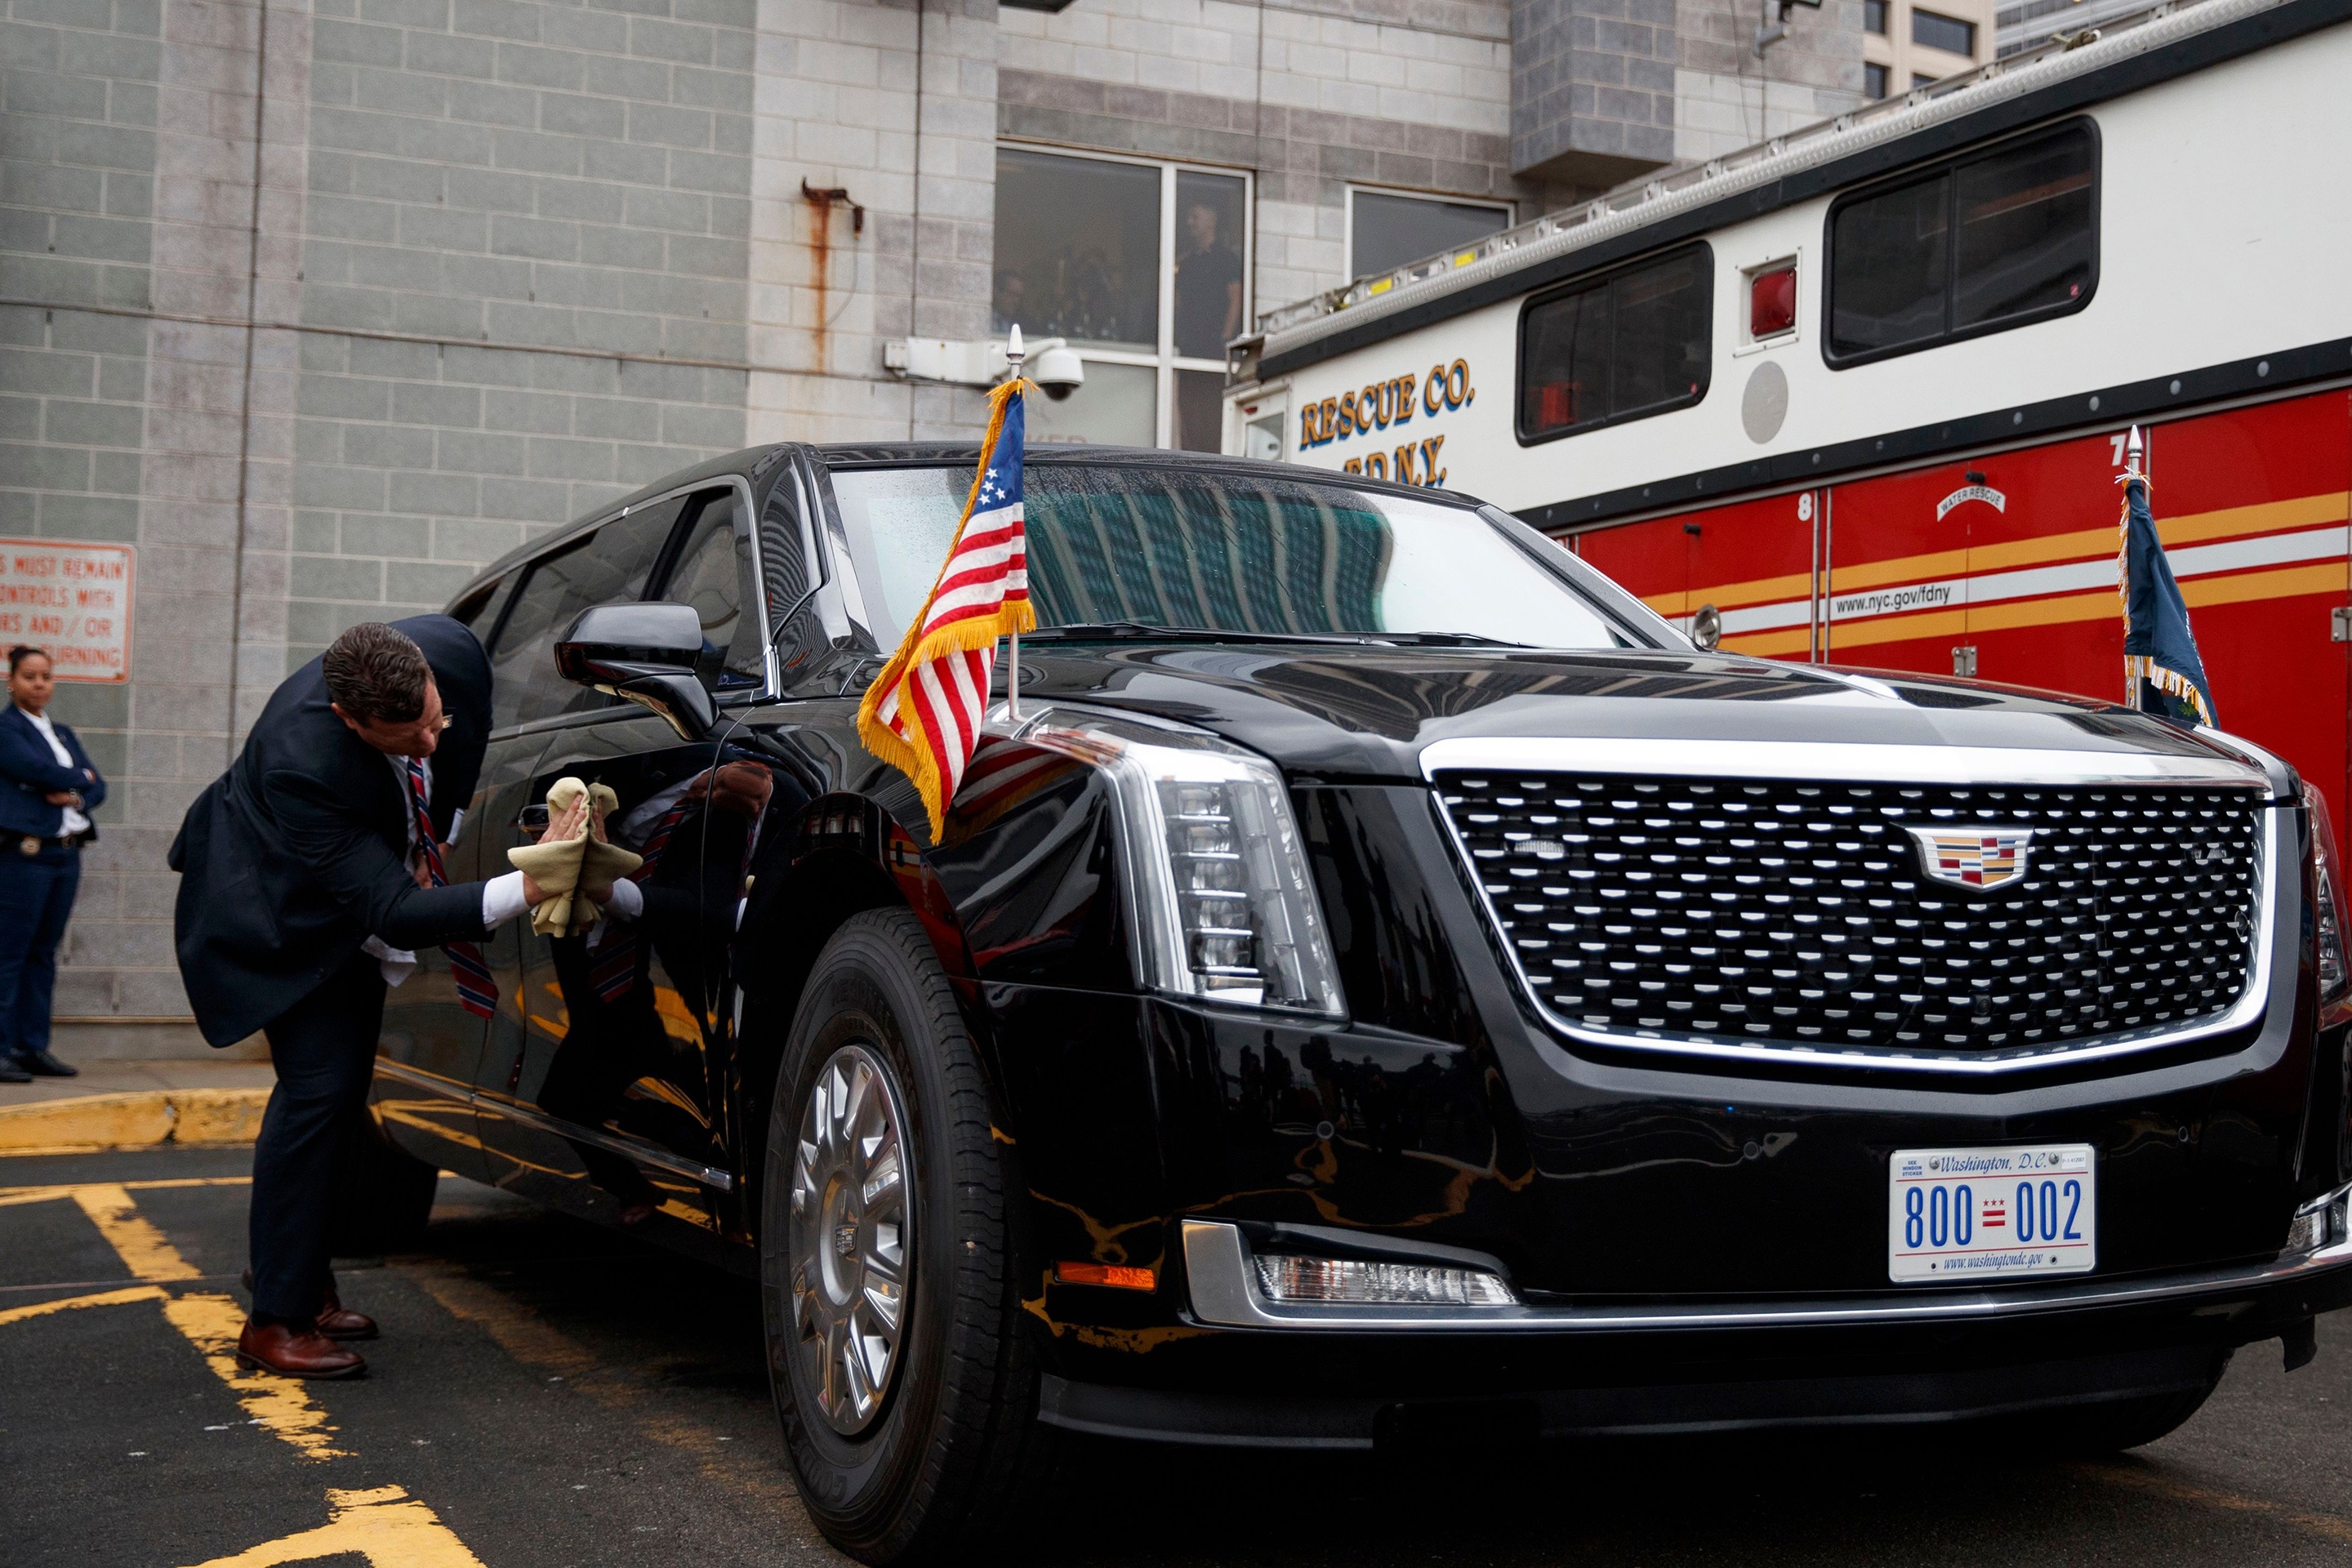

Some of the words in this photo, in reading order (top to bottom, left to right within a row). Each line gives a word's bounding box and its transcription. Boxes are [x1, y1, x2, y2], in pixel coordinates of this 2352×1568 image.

[1299, 373, 1417, 452] RESCUE
[1423, 359, 1475, 417] CO.
[2109, 434, 2127, 466] 7
[1797, 492, 1812, 522] 8
[1940, 489, 1967, 512] WATER
[1969, 488, 2001, 506] RESCUE
[15, 557, 56, 577] MUST
[64, 559, 123, 580] REMAIN
[76, 589, 114, 609] WITH
[1837, 584, 1950, 612] www.nyc.gov/fdny
[39, 643, 122, 668] URNING
[1940, 1156, 2012, 1174] Washington,
[2018, 1152, 2047, 1169] D.C.
[1905, 1184, 1972, 1249] 800
[2016, 1179, 2082, 1242] 002
[1944, 1251, 2043, 1271] www.washingtondc.gov
